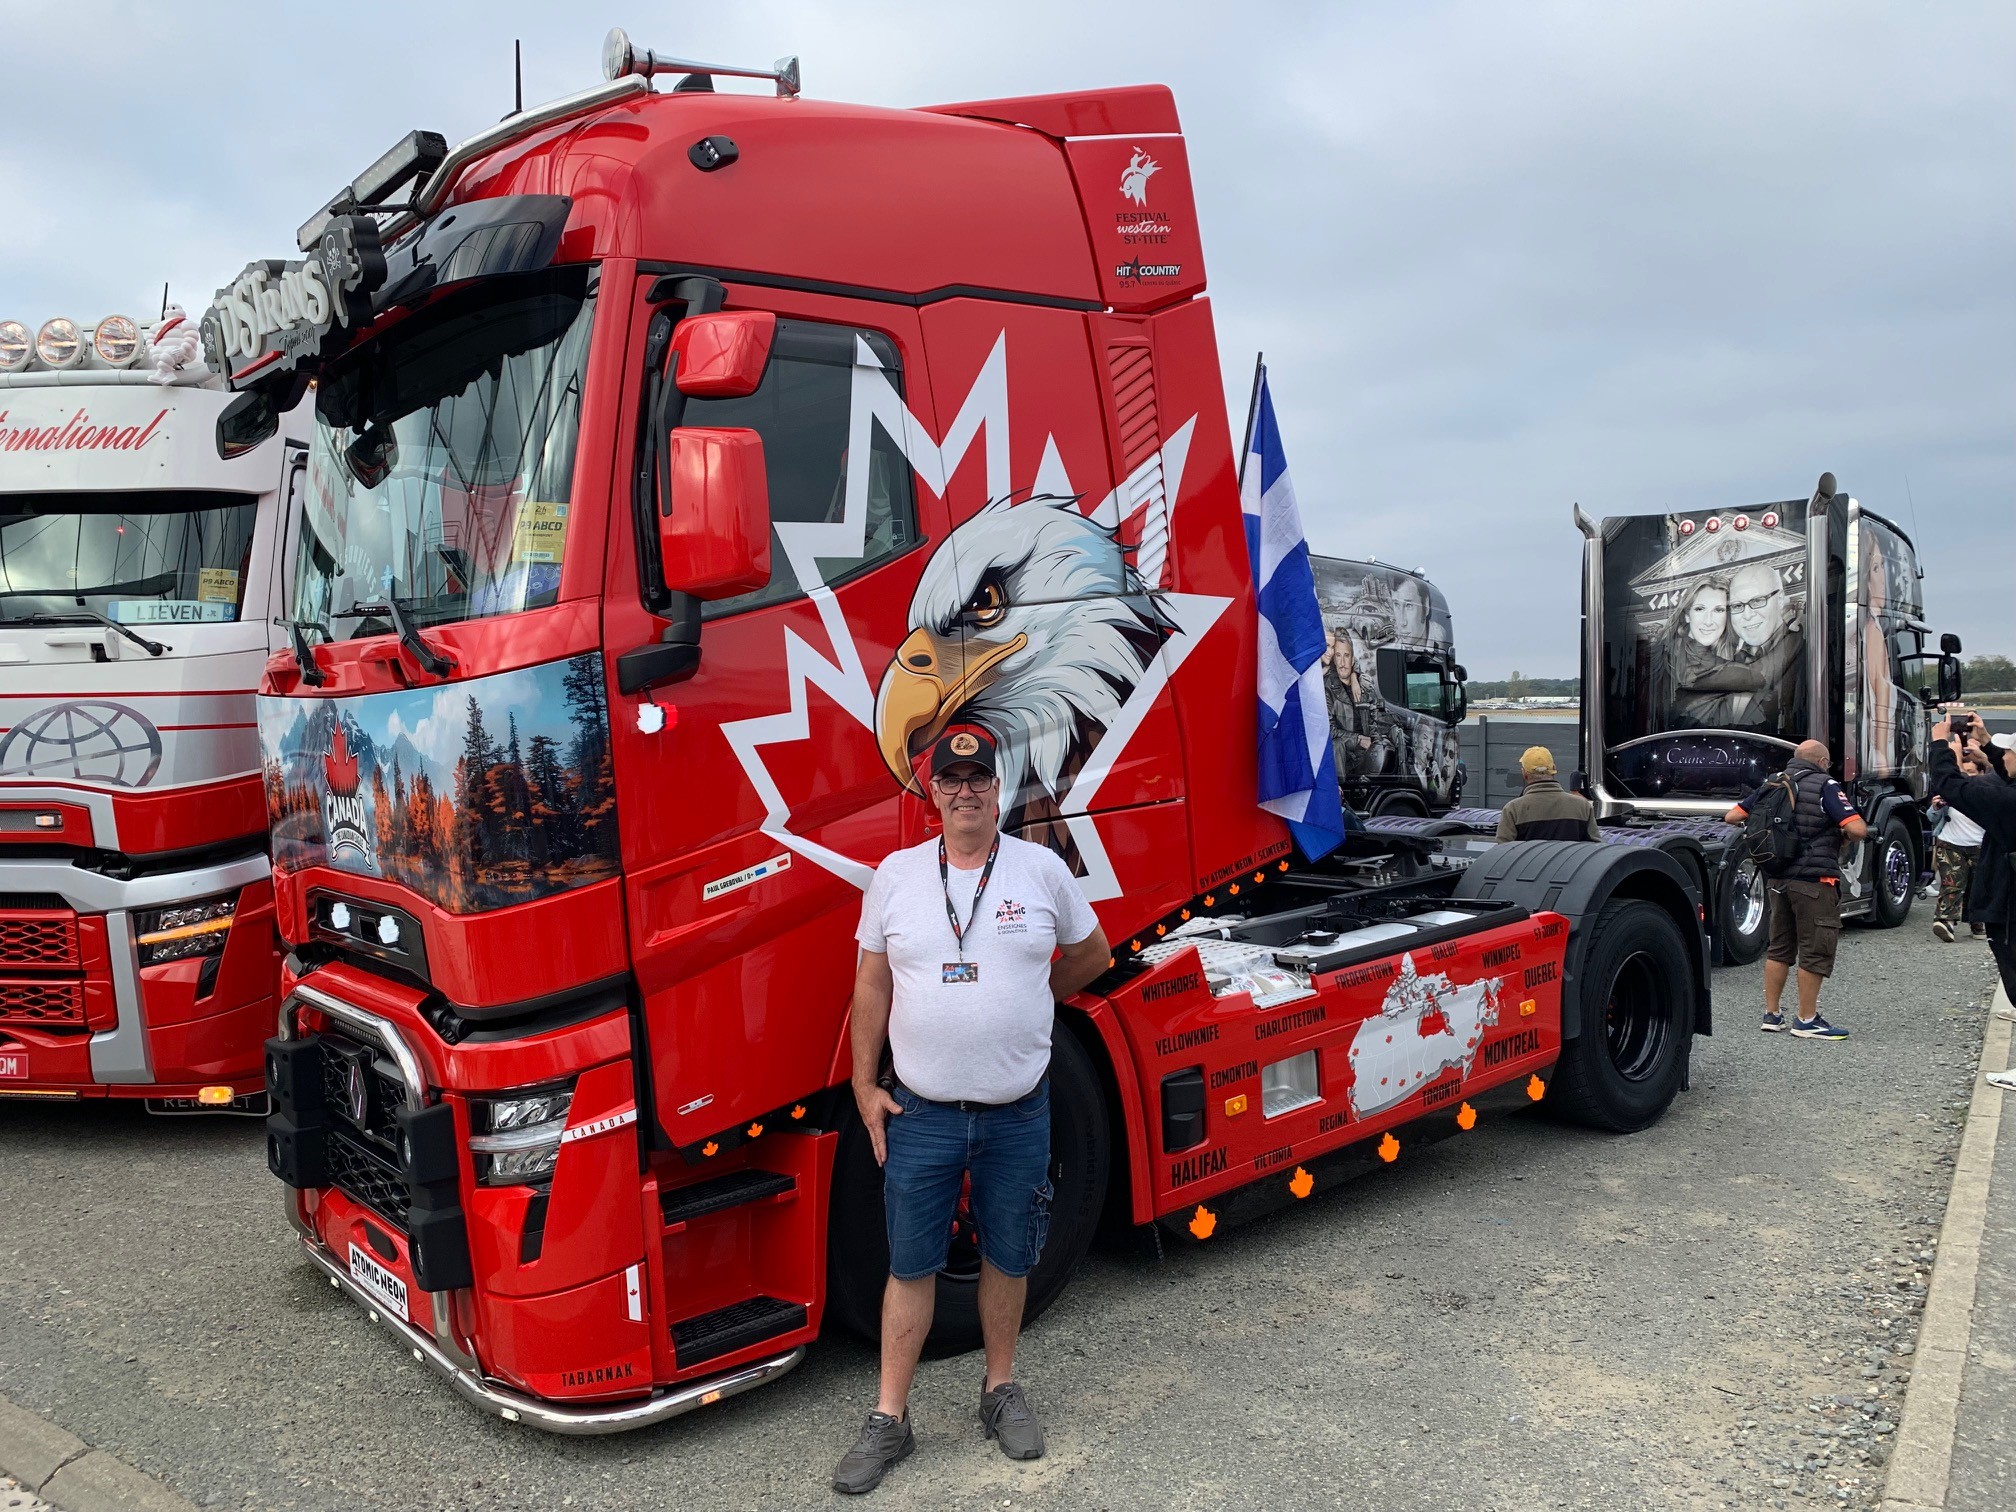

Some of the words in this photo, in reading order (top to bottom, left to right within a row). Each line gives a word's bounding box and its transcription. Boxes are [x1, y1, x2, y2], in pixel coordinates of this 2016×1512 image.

[1116, 212, 1170, 222] FESTIVAL
[1117, 220, 1171, 234] western
[1116, 266, 1131, 276] HIT
[1139, 266, 1180, 276] COUNTRY
[1119, 280, 1136, 288] 95.7
[533, 521, 562, 531] ABCD
[214, 578, 234, 586] ABCD
[137, 604, 202, 620] LIEVEN
[327, 794, 368, 838] CANADA
[1200, 876, 1210, 888] BY
[1210, 864, 1234, 883] ATOMIC
[1235, 855, 1253, 871] NEON
[707, 884, 720, 894] PAUL
[997, 923, 1027, 931] ENSEIGNES
[1482, 943, 1521, 969] WINNIPEG
[1334, 962, 1394, 991] FREDERICTOWN
[1524, 961, 1557, 989] QUEBEC
[1141, 973, 1199, 1003] WHITEHORSE
[1255, 1005, 1326, 1041] CHARLOTTETOWN
[1155, 1023, 1219, 1057] YELLOWKNIFE
[1484, 1028, 1539, 1068] MONTREAL
[1210, 1060, 1258, 1090] EDMONTON
[1422, 1078, 1461, 1107] TORONTO
[572, 1116, 625, 1138] CANADA
[1319, 1110, 1348, 1133] REGINA
[1171, 1146, 1228, 1188] HALIFAX
[1254, 1145, 1293, 1170] VICTORIA
[352, 1249, 379, 1285] ATOMIC
[380, 1273, 406, 1305] NEON
[562, 1363, 633, 1387] TABARNAK
